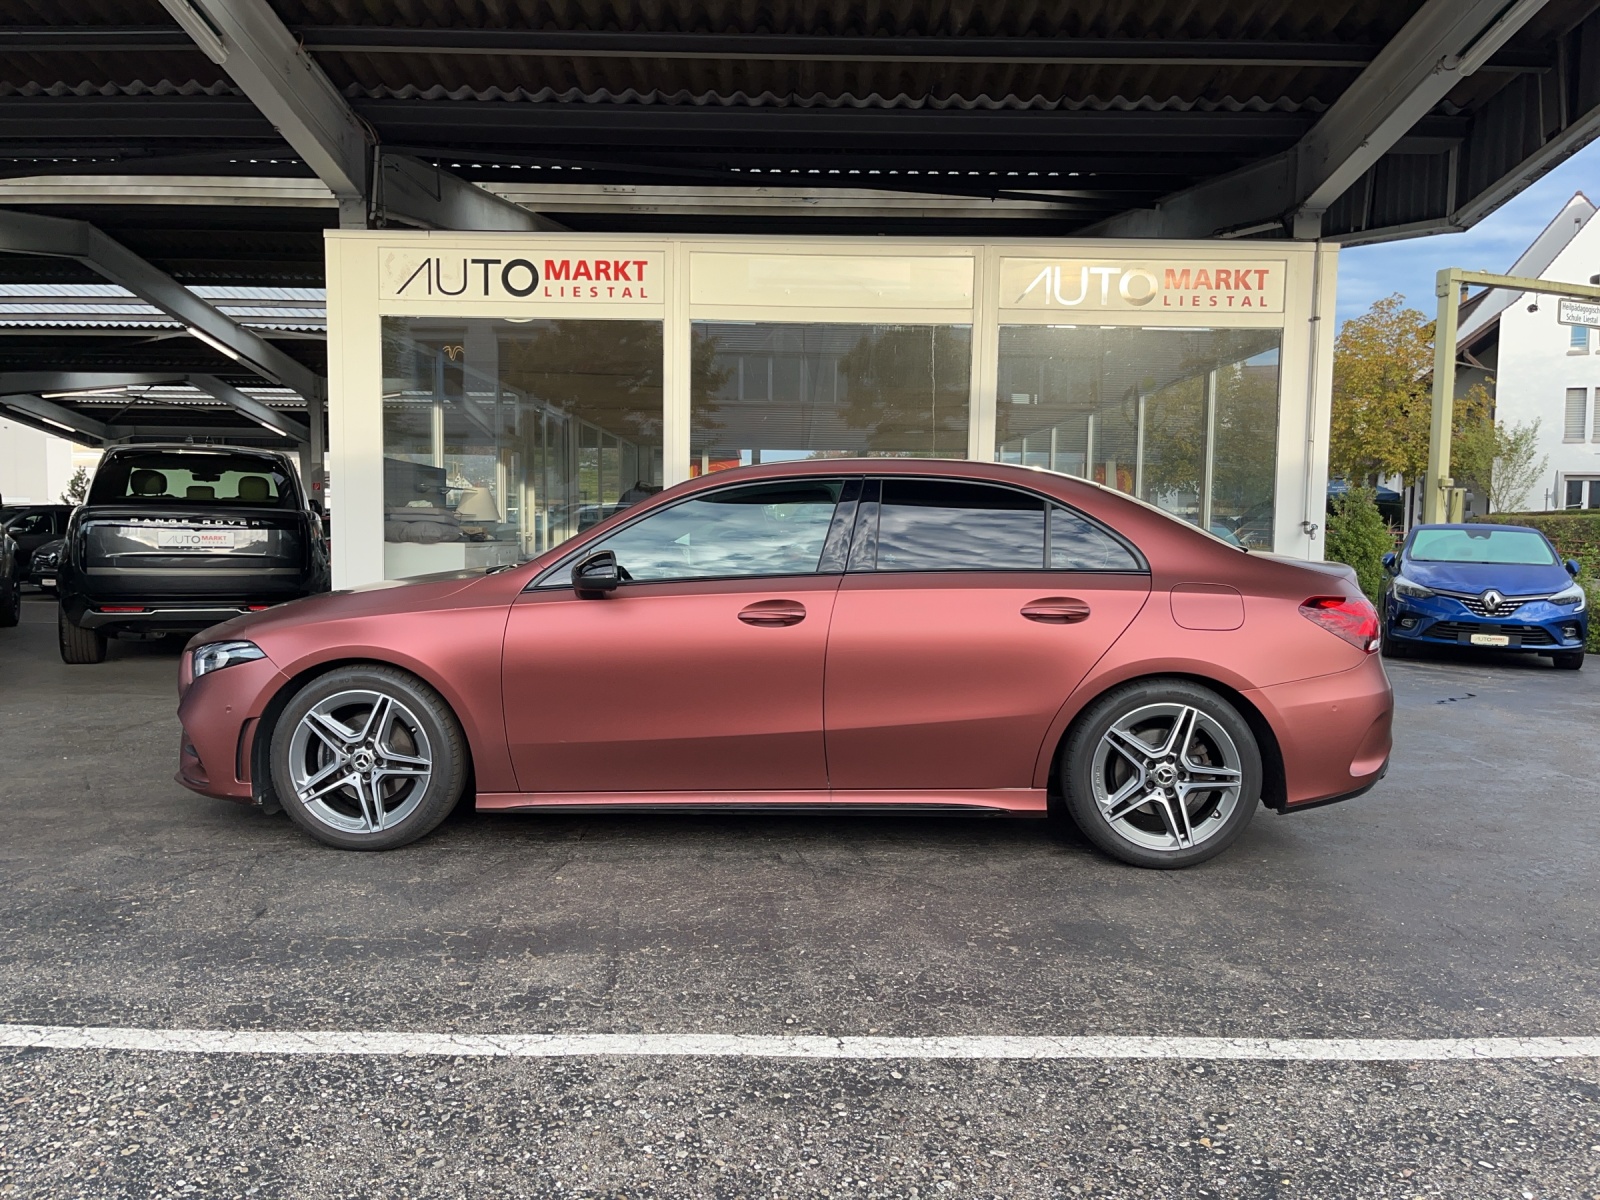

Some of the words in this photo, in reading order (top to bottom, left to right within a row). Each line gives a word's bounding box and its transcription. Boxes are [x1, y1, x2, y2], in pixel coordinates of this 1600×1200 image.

[396, 257, 539, 297] AUTO
[544, 259, 648, 281] MARKT
[544, 286, 648, 298] LIESTAL
[1015, 266, 1158, 306] AUTO
[1164, 268, 1269, 290] MARKT
[1163, 295, 1268, 307] LIESTAL
[1566, 313, 1581, 322] Schule
[1583, 314, 1598, 323] Liestal
[166, 535, 200, 544] AUTO
